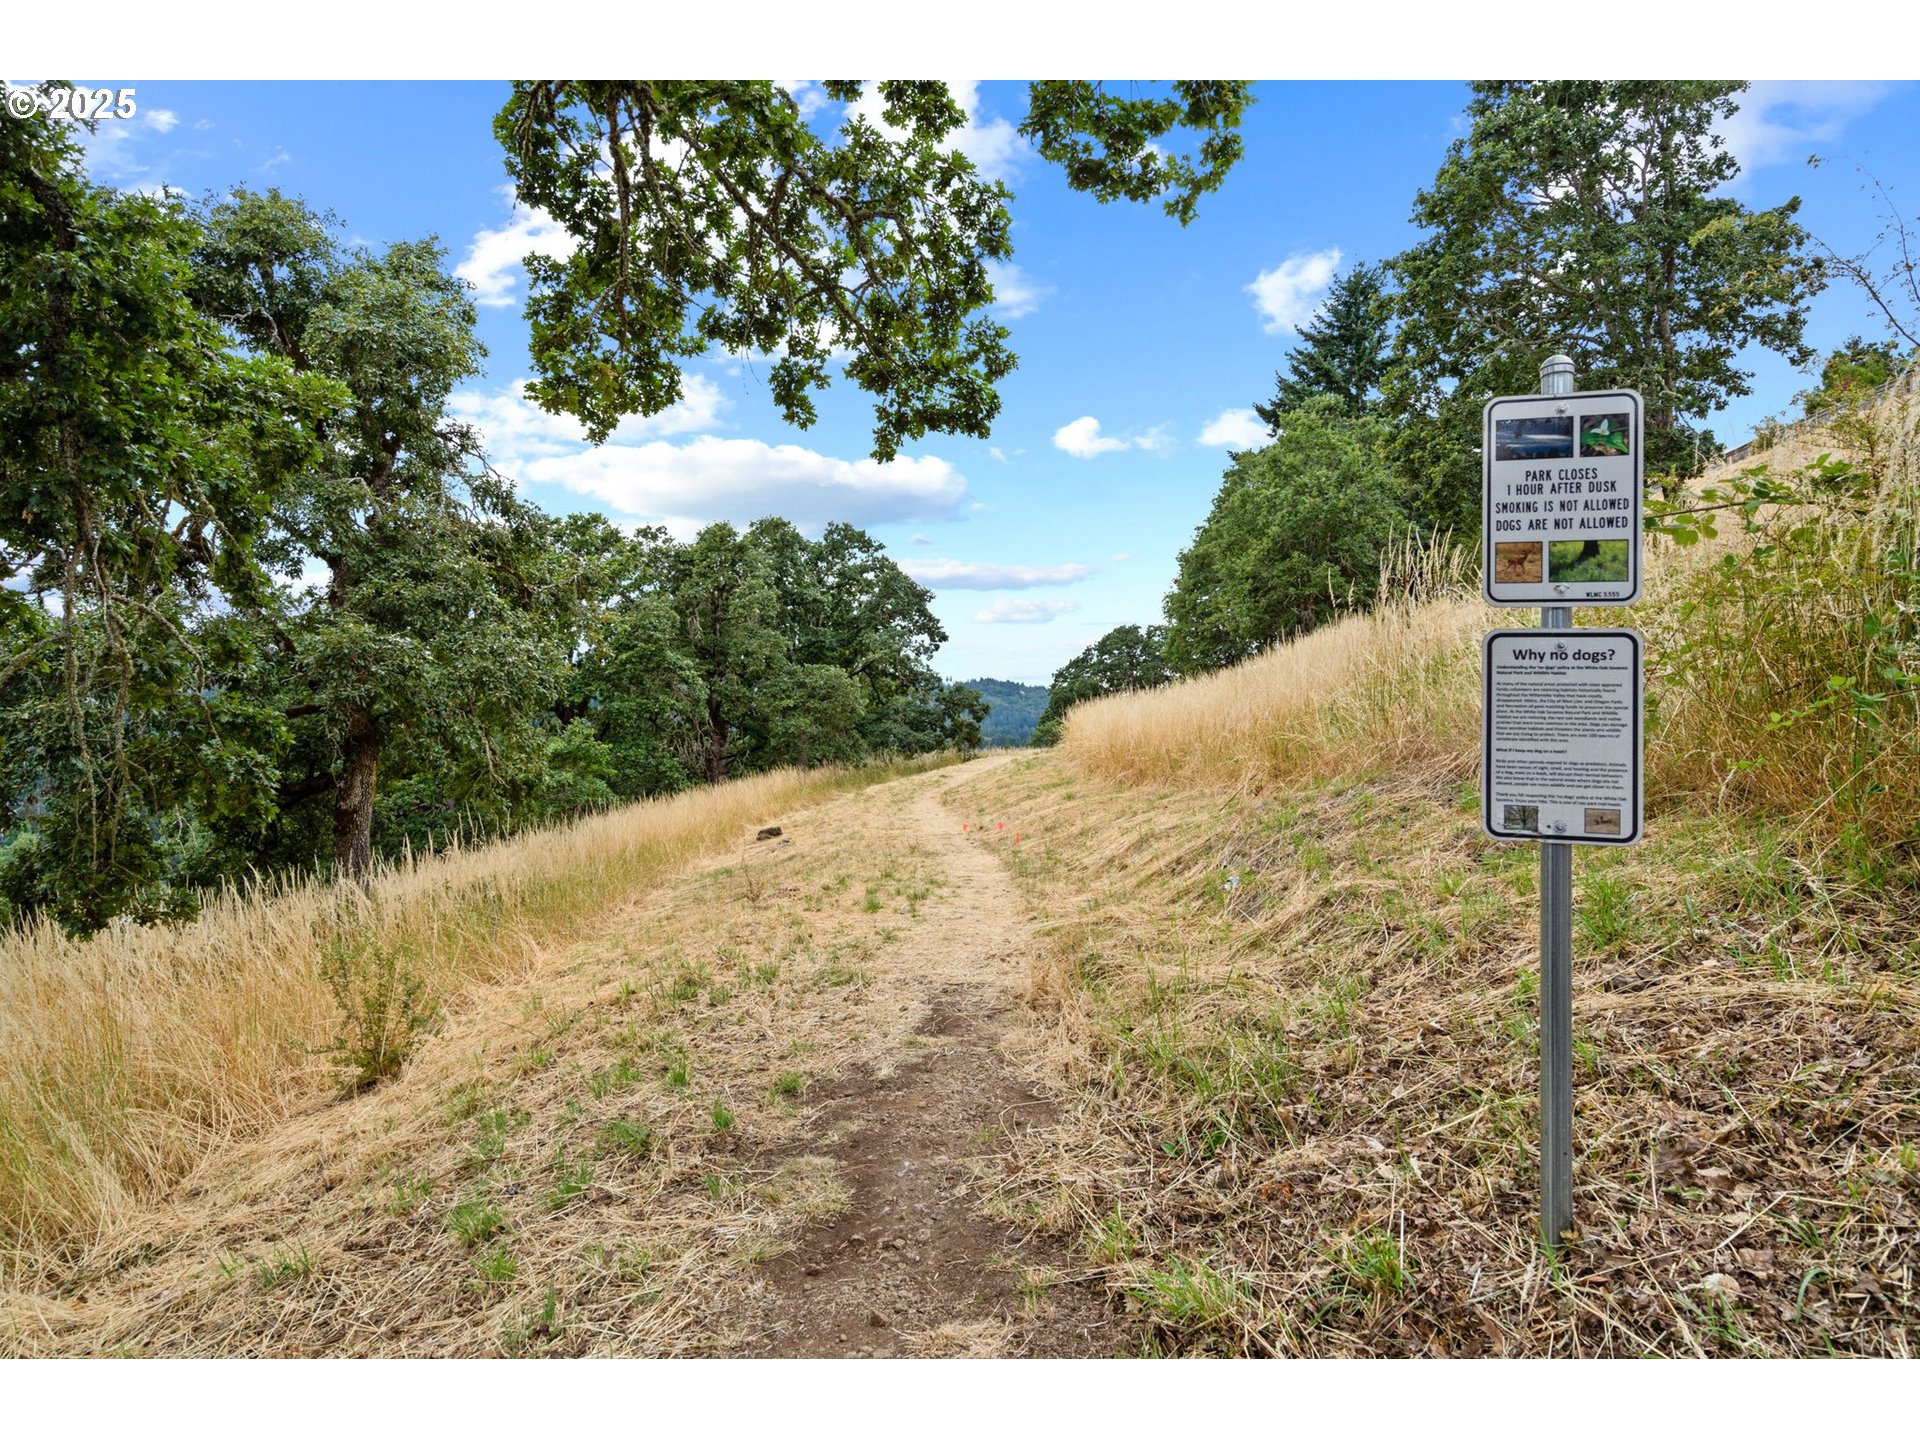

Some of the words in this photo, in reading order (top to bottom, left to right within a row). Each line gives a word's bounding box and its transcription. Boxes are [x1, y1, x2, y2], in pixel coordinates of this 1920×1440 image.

[1525, 470, 1552, 482] PARK
[1558, 468, 1598, 480] CLOSES
[1507, 485, 1511, 496] 1
[1515, 484, 1544, 495] HOUR
[1550, 482, 1582, 494] AFTER
[1588, 481, 1617, 492] DUSK
[1495, 502, 1538, 514] SMOKING
[1544, 501, 1554, 512] IS
[1559, 500, 1578, 511] NOT
[1583, 498, 1629, 511] ALLOWED
[1496, 520, 1522, 531] DOGS
[1528, 519, 1548, 530] ARE
[1554, 518, 1574, 529] NOT
[1579, 516, 1628, 529] ALLOWED
[1512, 648, 1546, 663] Why
[1550, 651, 1569, 661] no
[1572, 648, 1616, 664] dogs?
